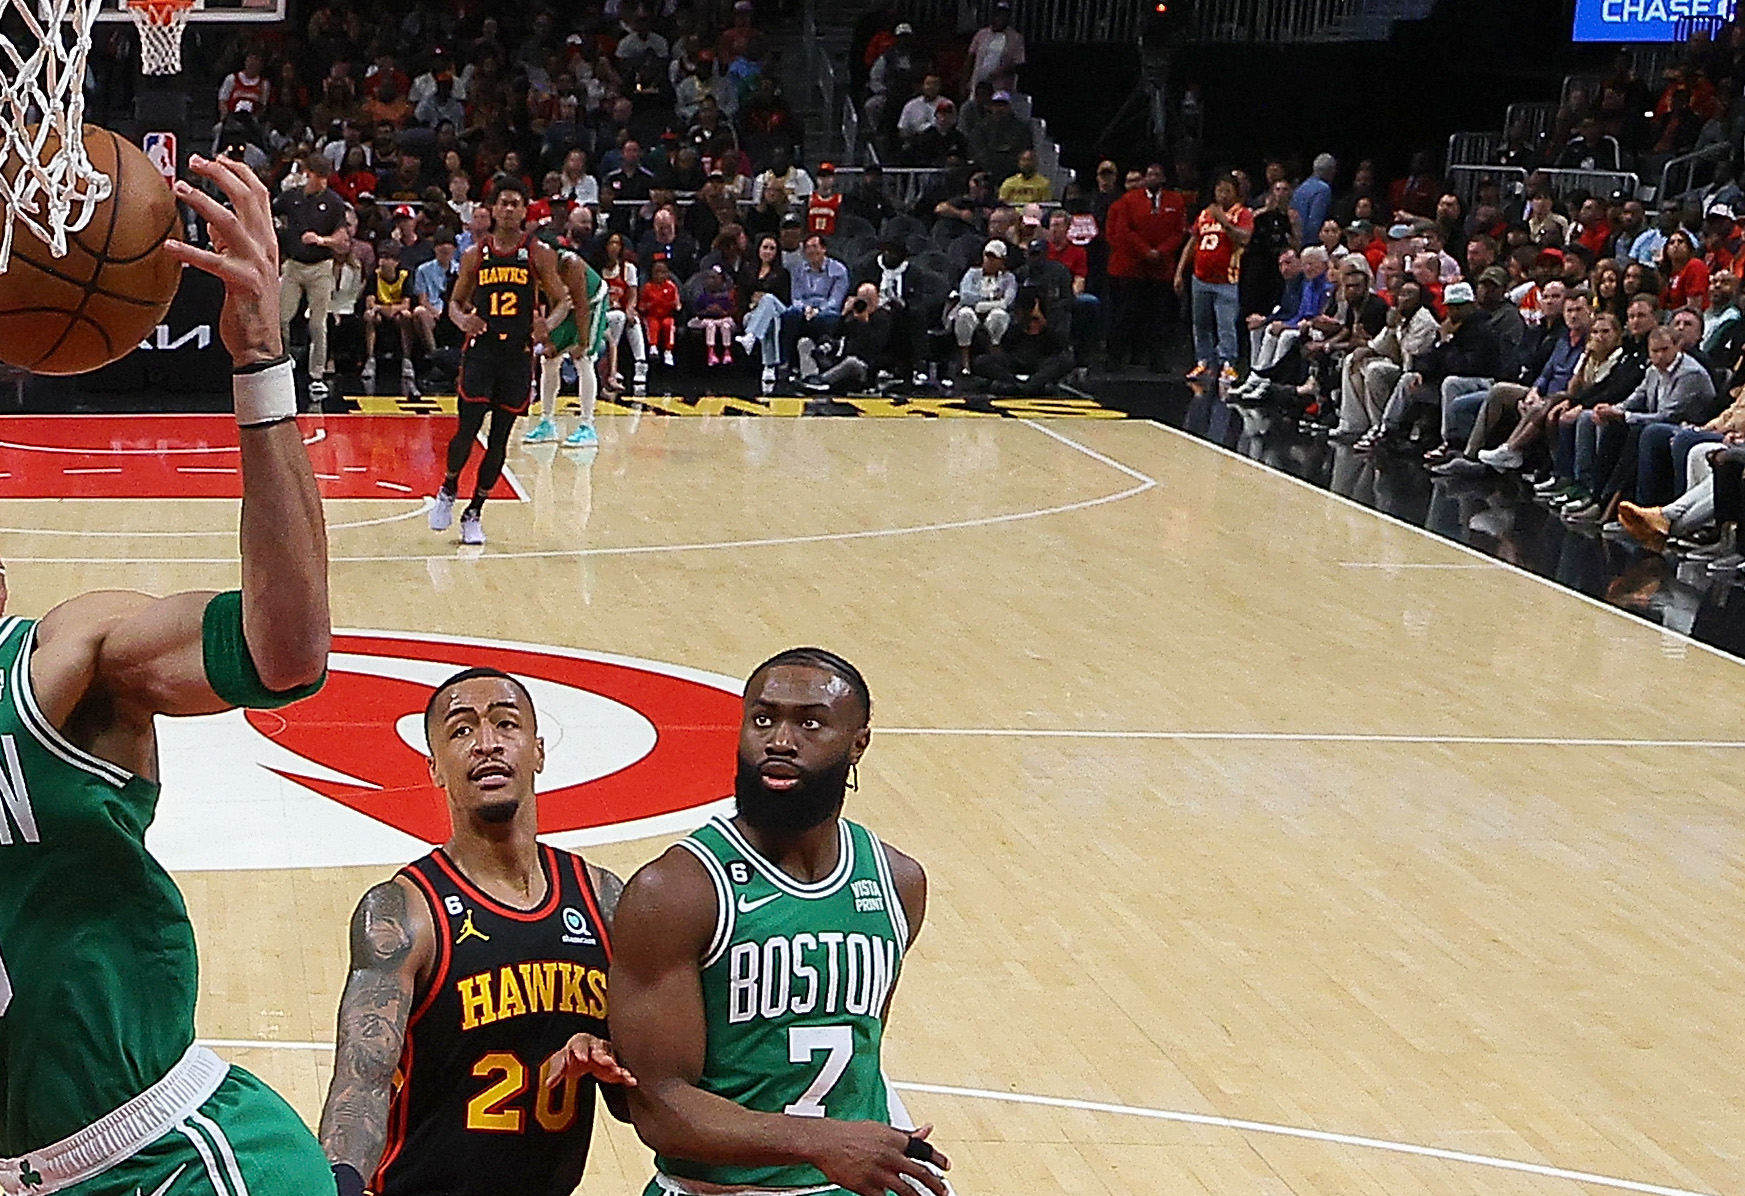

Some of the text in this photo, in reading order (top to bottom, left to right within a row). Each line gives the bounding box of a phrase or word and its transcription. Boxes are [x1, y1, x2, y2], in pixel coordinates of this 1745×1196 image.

[478, 266, 529, 286] HAWKS
[489, 291, 519, 316] 12
[139, 325, 212, 350] IA
[341, 395, 1129, 420] HAWKS
[730, 862, 748, 883] 6
[850, 878, 882, 898] VISTA
[444, 895, 465, 916] 6
[855, 896, 885, 913] PRINT
[729, 932, 895, 1024] BOSTON
[456, 961, 609, 1032] HAWKS
[784, 1024, 854, 1118] 7
[464, 1051, 579, 1133] 20
